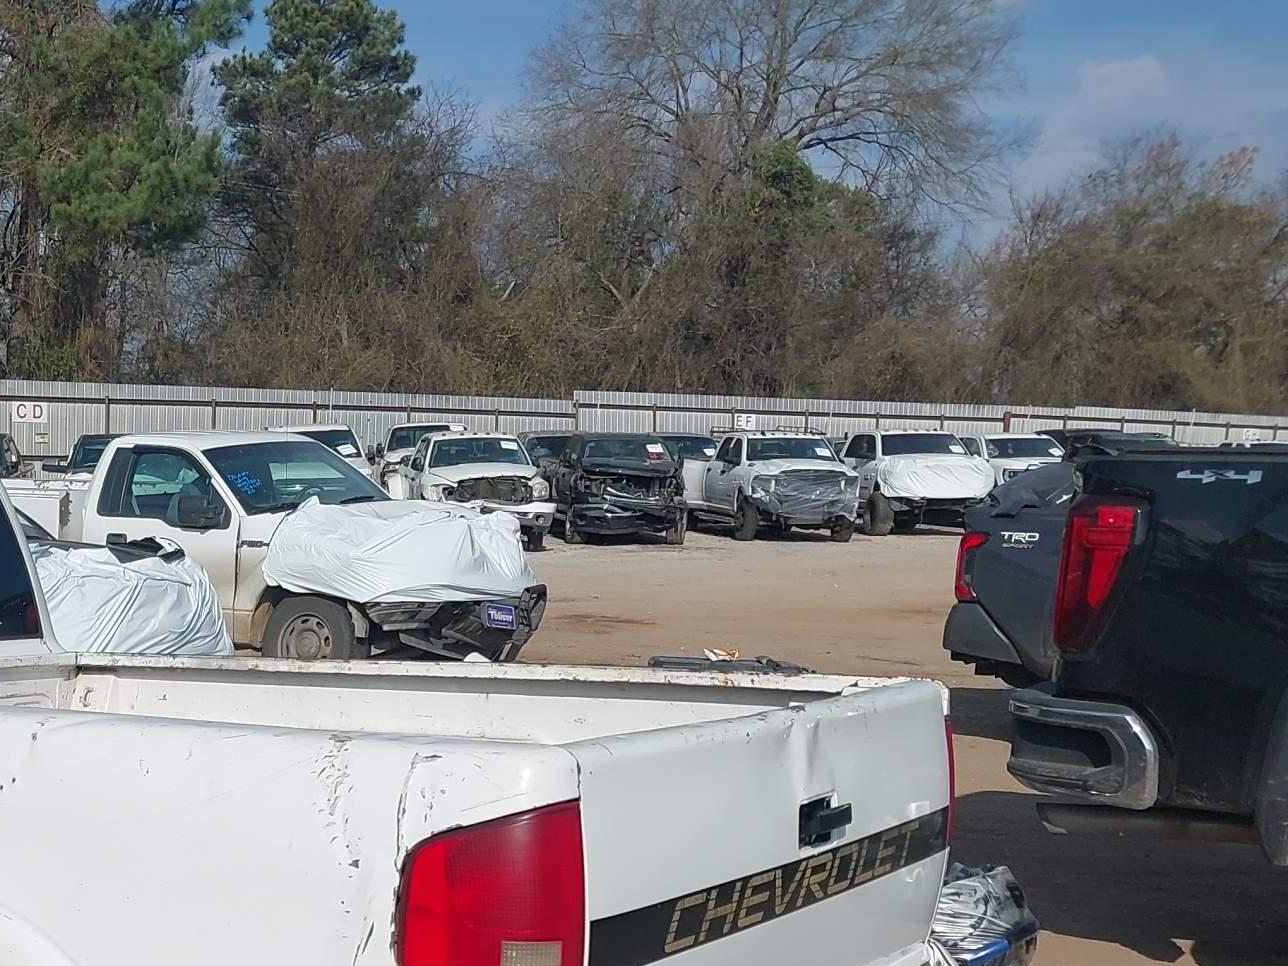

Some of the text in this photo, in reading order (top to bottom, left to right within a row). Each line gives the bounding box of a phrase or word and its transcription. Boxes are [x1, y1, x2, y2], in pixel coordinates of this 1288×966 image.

[16, 403, 44, 419] C D
[1000, 531, 1040, 543] TRD
[664, 821, 920, 953] CHEVROLET
